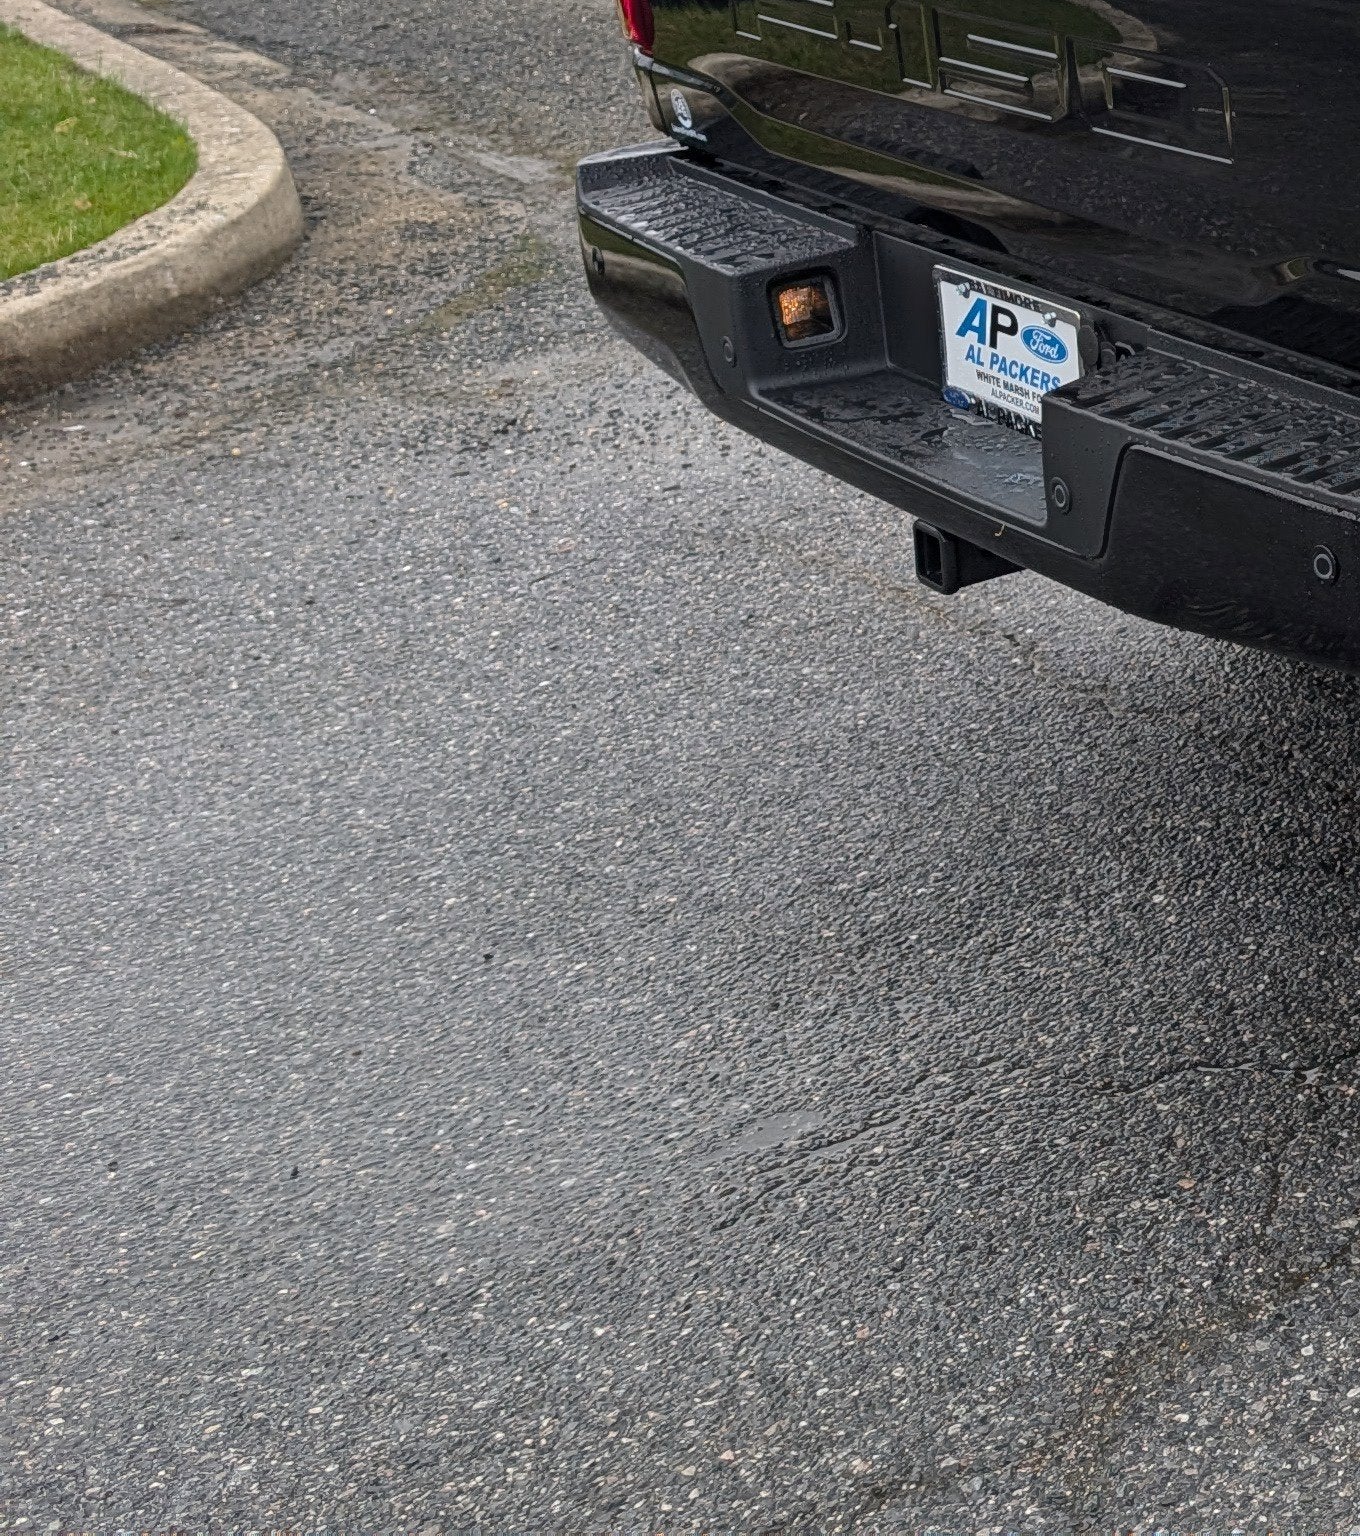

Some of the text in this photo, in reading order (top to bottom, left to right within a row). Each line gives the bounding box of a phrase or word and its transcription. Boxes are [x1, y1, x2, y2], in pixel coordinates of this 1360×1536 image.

[955, 297, 1019, 350] AP
[1029, 329, 1059, 360] Ford
[964, 344, 1062, 392] AL PACKERS
[975, 368, 1042, 404] WHITE MARSH FO
